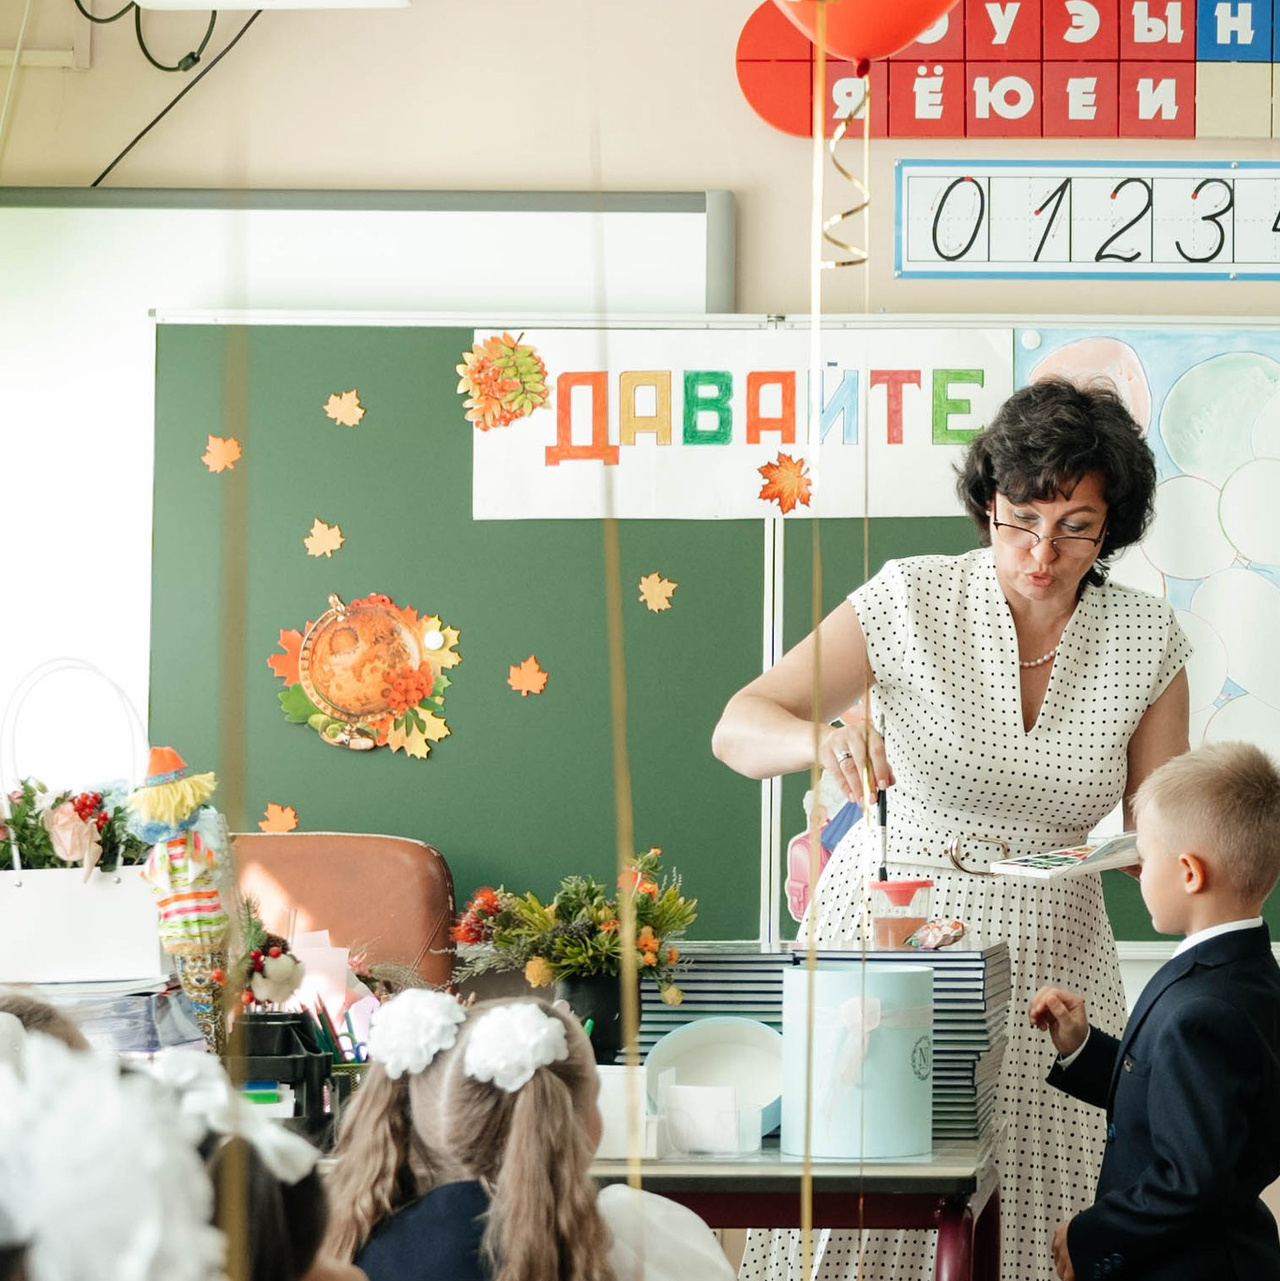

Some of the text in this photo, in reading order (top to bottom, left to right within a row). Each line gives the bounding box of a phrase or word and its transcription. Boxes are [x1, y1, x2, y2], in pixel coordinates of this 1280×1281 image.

[985, 2, 1021, 44] У
[1063, 0, 1100, 43] Э
[1132, 1, 1184, 44] Ы
[1214, 3, 1254, 44] Н
[832, 78, 867, 120] Я
[912, 64, 944, 120] Ё
[972, 76, 1034, 120] Ю
[1066, 77, 1097, 120] Е
[1136, 78, 1179, 120] И
[932, 176, 985, 261] 0
[1033, 177, 1072, 262] 1
[1094, 178, 1152, 263] 2
[1175, 178, 1234, 263] 3
[545, 361, 985, 466] ДАВАЙТЕ
